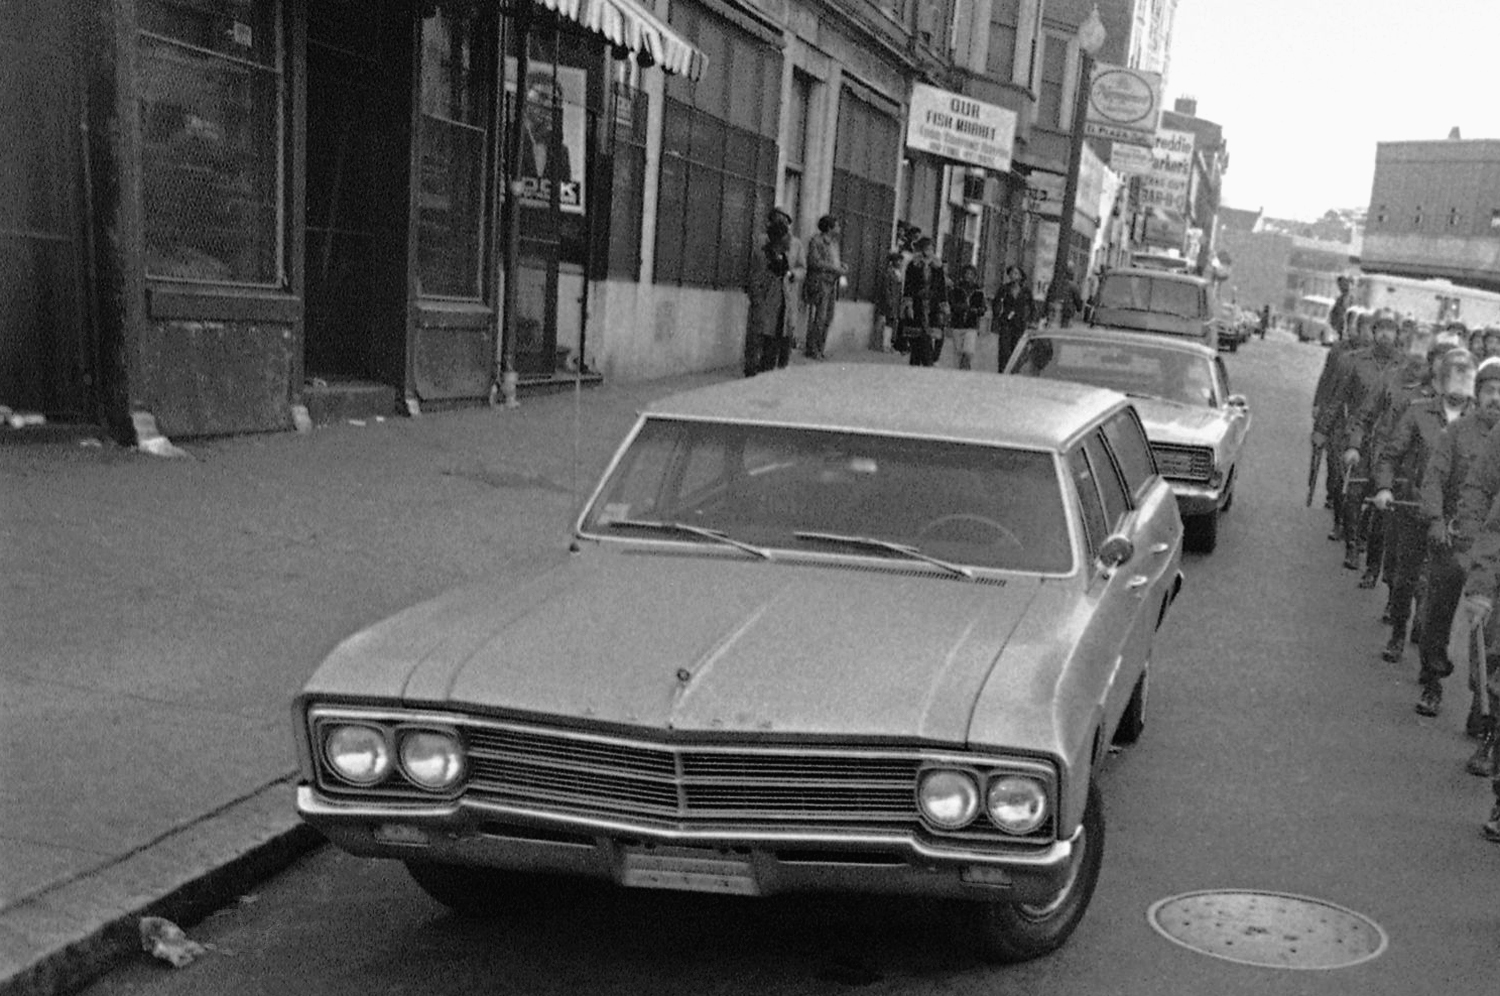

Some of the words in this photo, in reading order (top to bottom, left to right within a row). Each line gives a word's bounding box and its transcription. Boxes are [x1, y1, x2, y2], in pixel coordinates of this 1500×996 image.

[950, 98, 980, 119] OUR
[926, 110, 953, 129] FISH
[956, 118, 996, 141] MARKET
[1155, 133, 1192, 154] reddie
[1151, 153, 1189, 175] arker's
